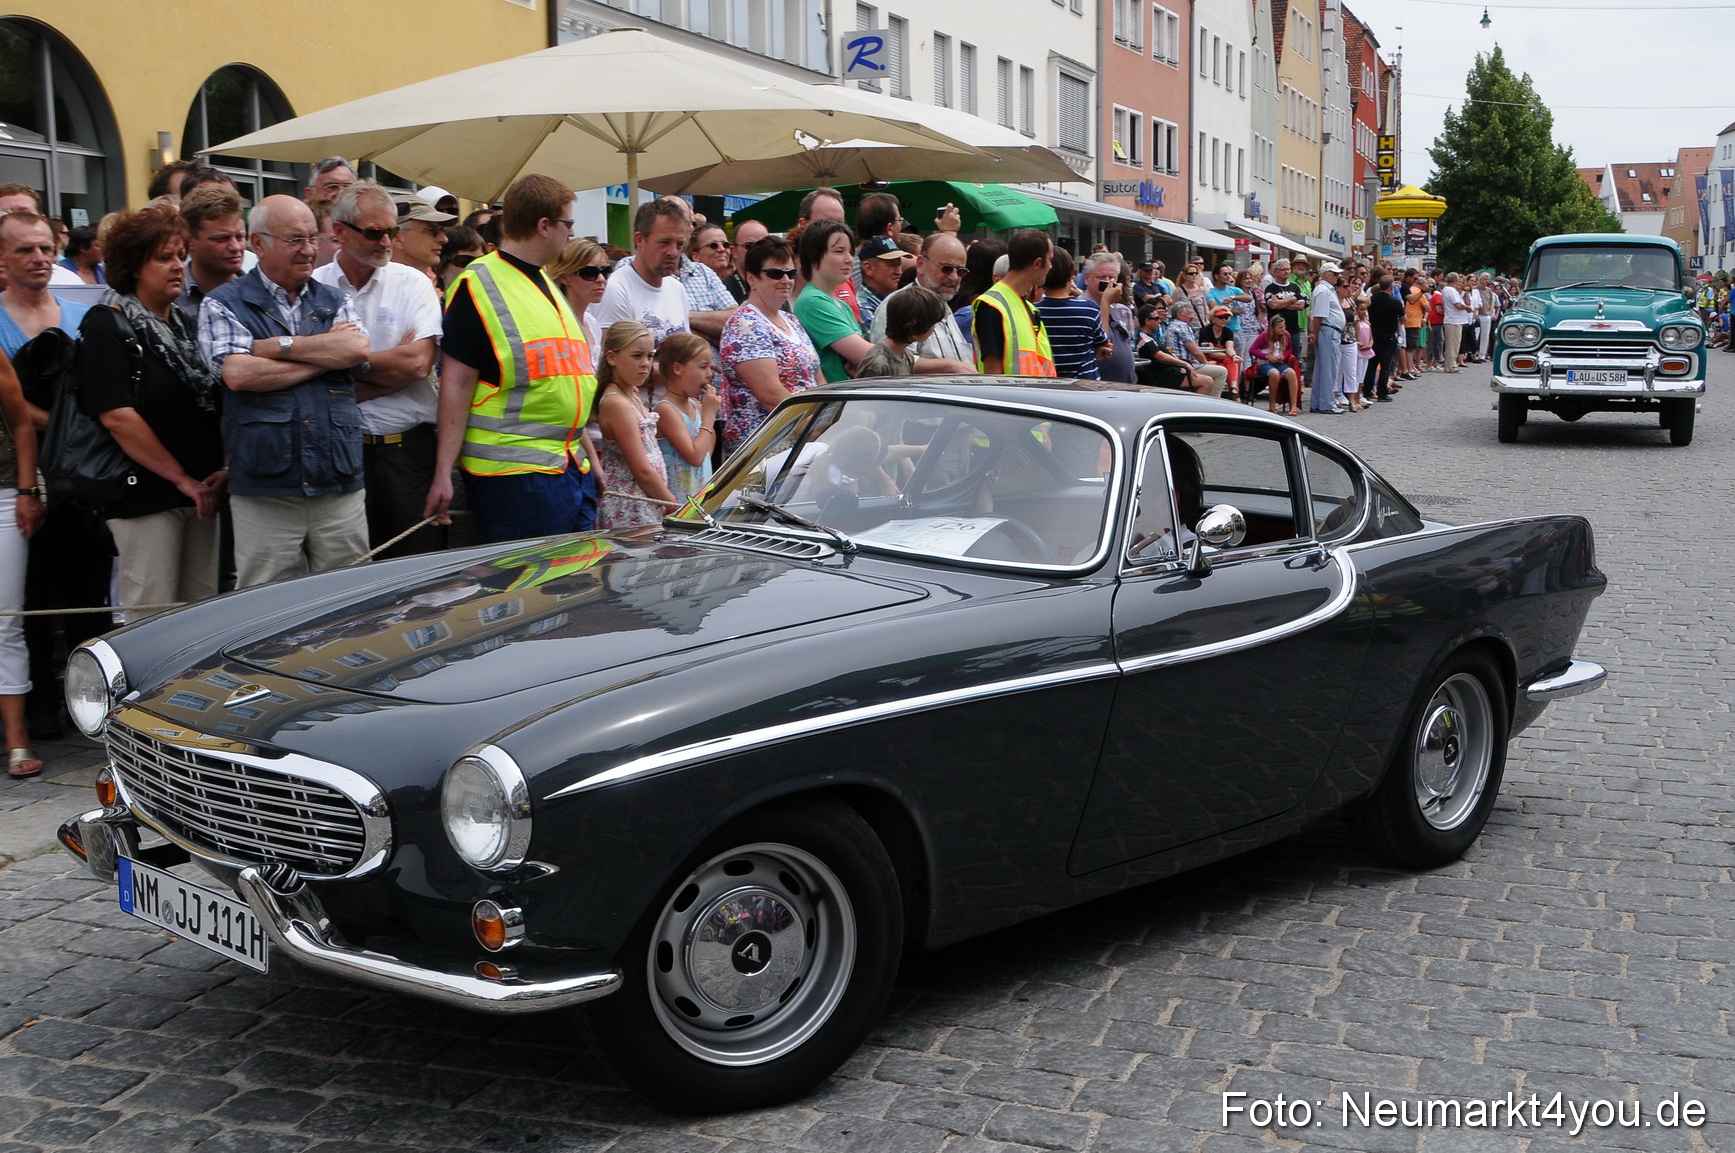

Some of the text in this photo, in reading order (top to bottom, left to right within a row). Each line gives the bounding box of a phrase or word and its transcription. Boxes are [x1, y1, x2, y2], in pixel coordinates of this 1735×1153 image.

[1573, 372, 1626, 382] LAU US 58H
[132, 869, 159, 918] NM
